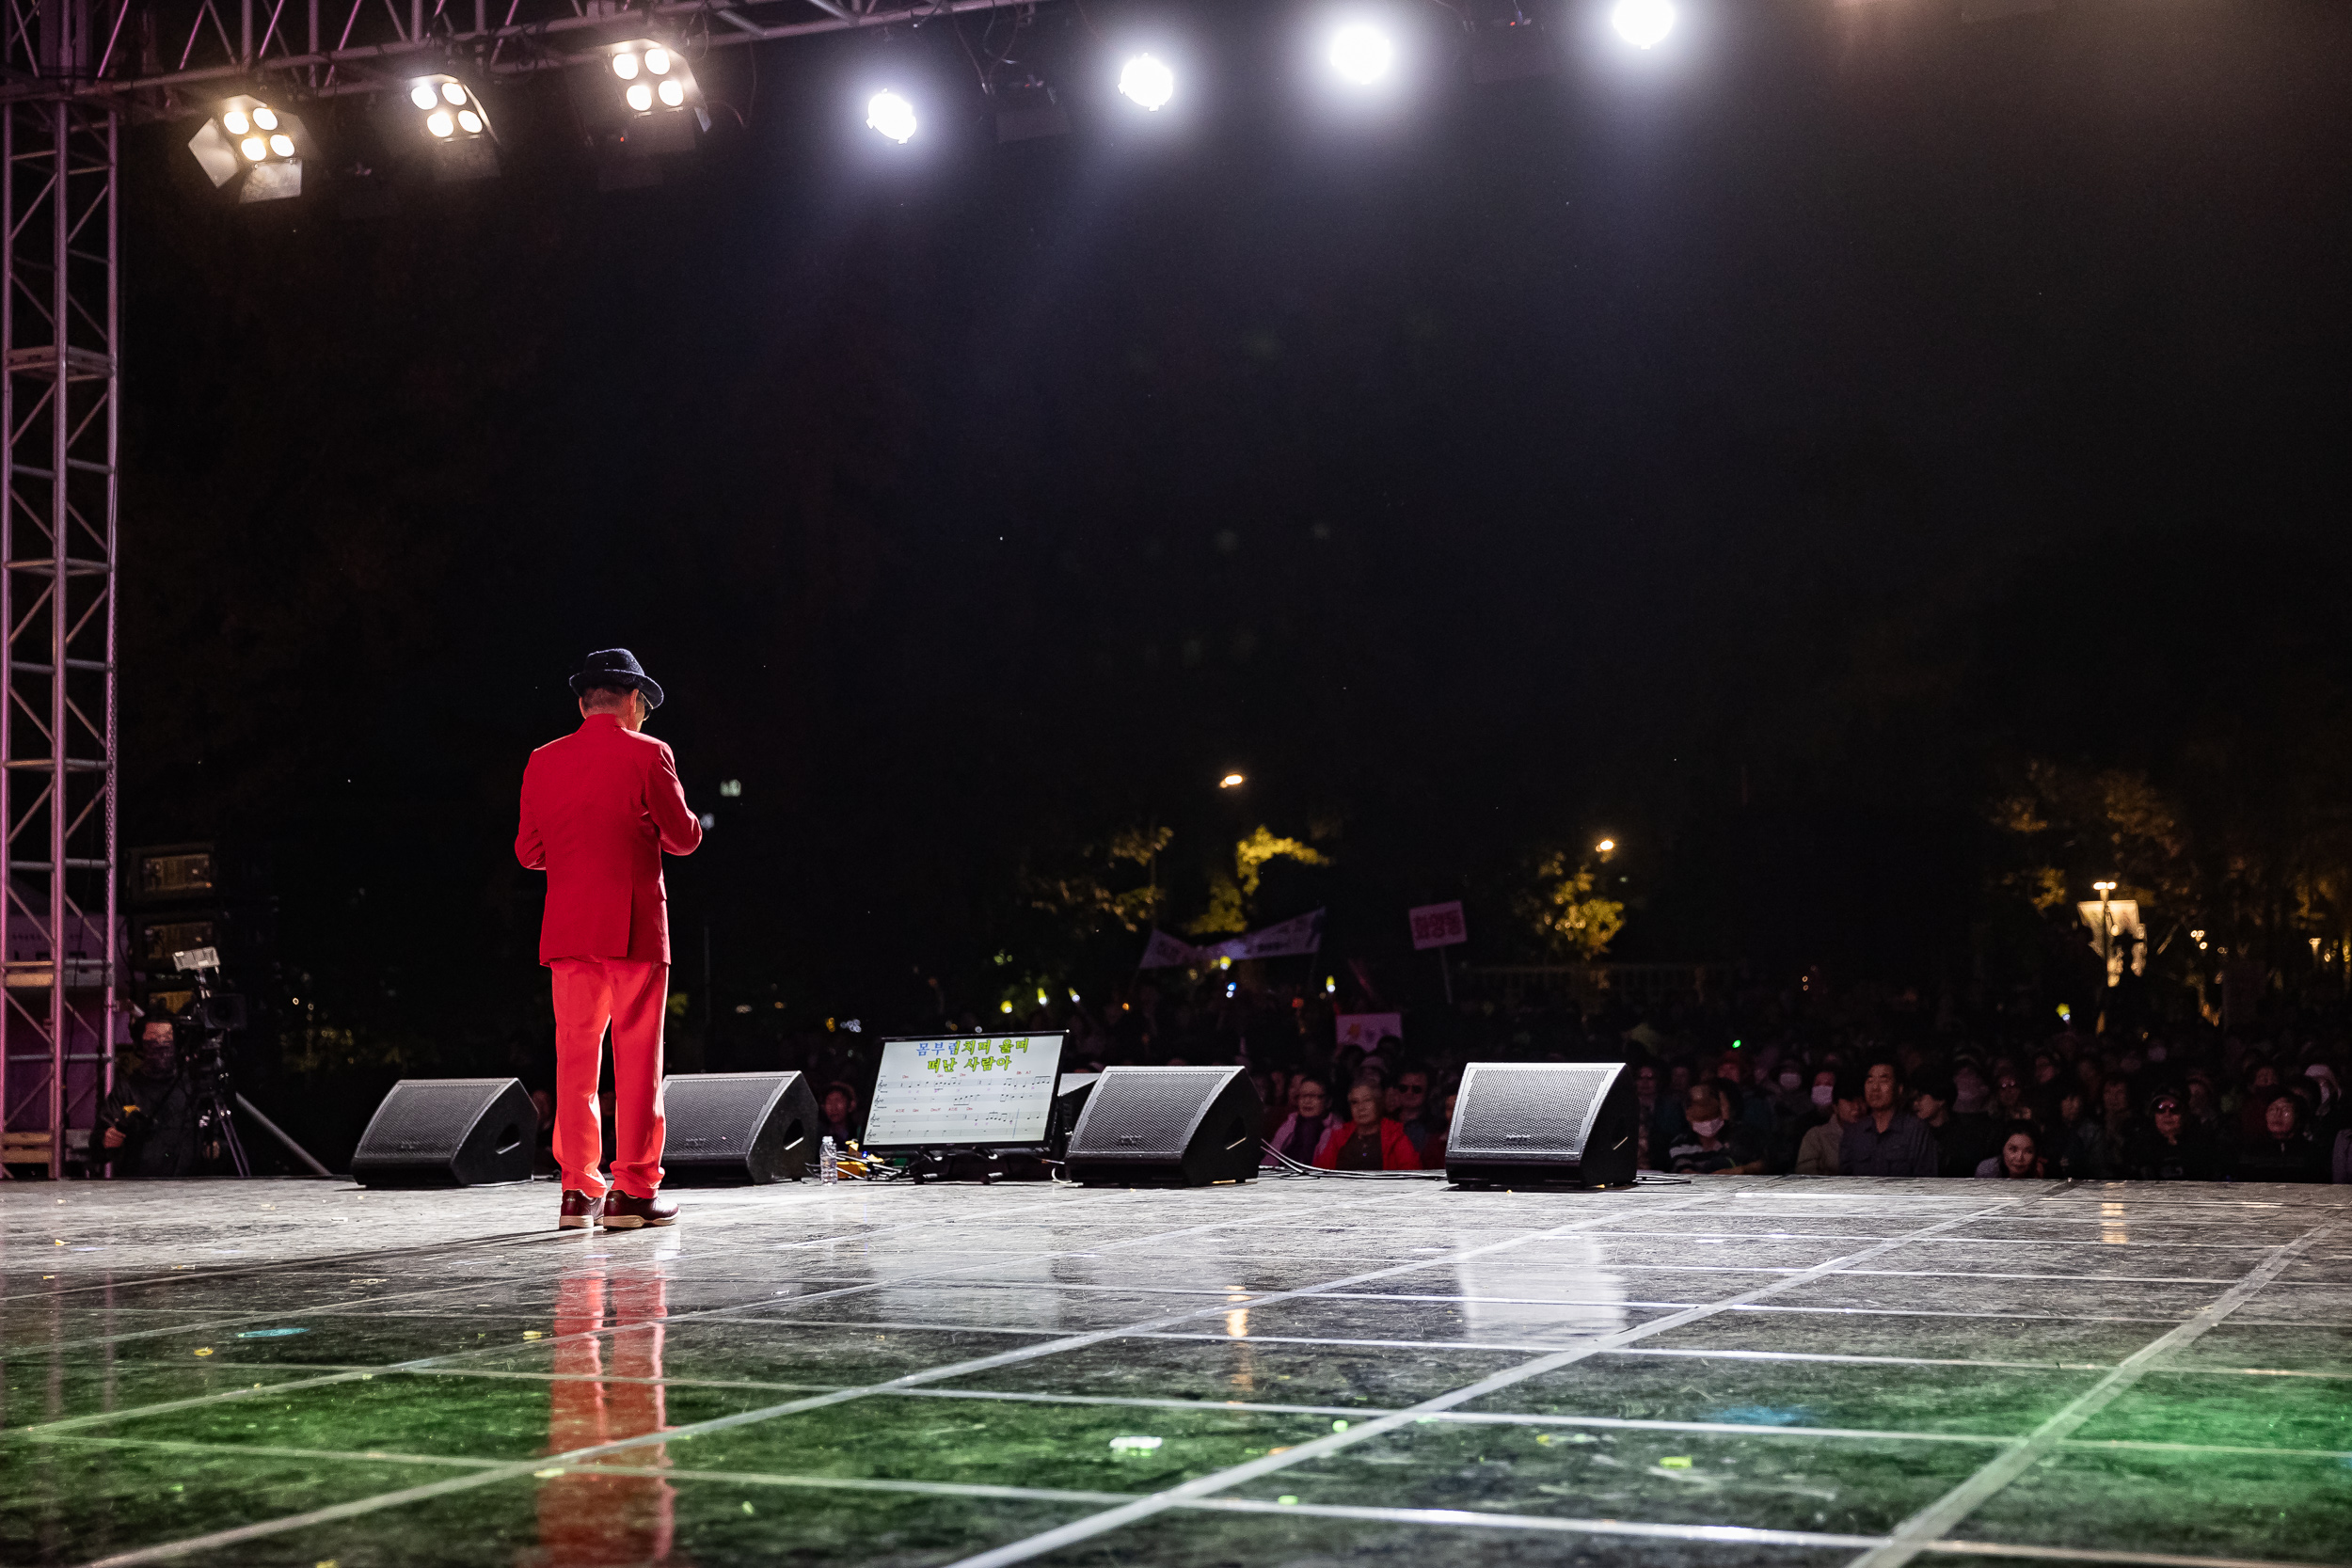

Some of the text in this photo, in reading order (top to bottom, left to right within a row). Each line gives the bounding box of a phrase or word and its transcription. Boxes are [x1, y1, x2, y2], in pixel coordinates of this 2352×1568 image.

[916, 1037, 1029, 1056] 몸부림치며 울며
[928, 1055, 1011, 1073] 떠난 사람아
